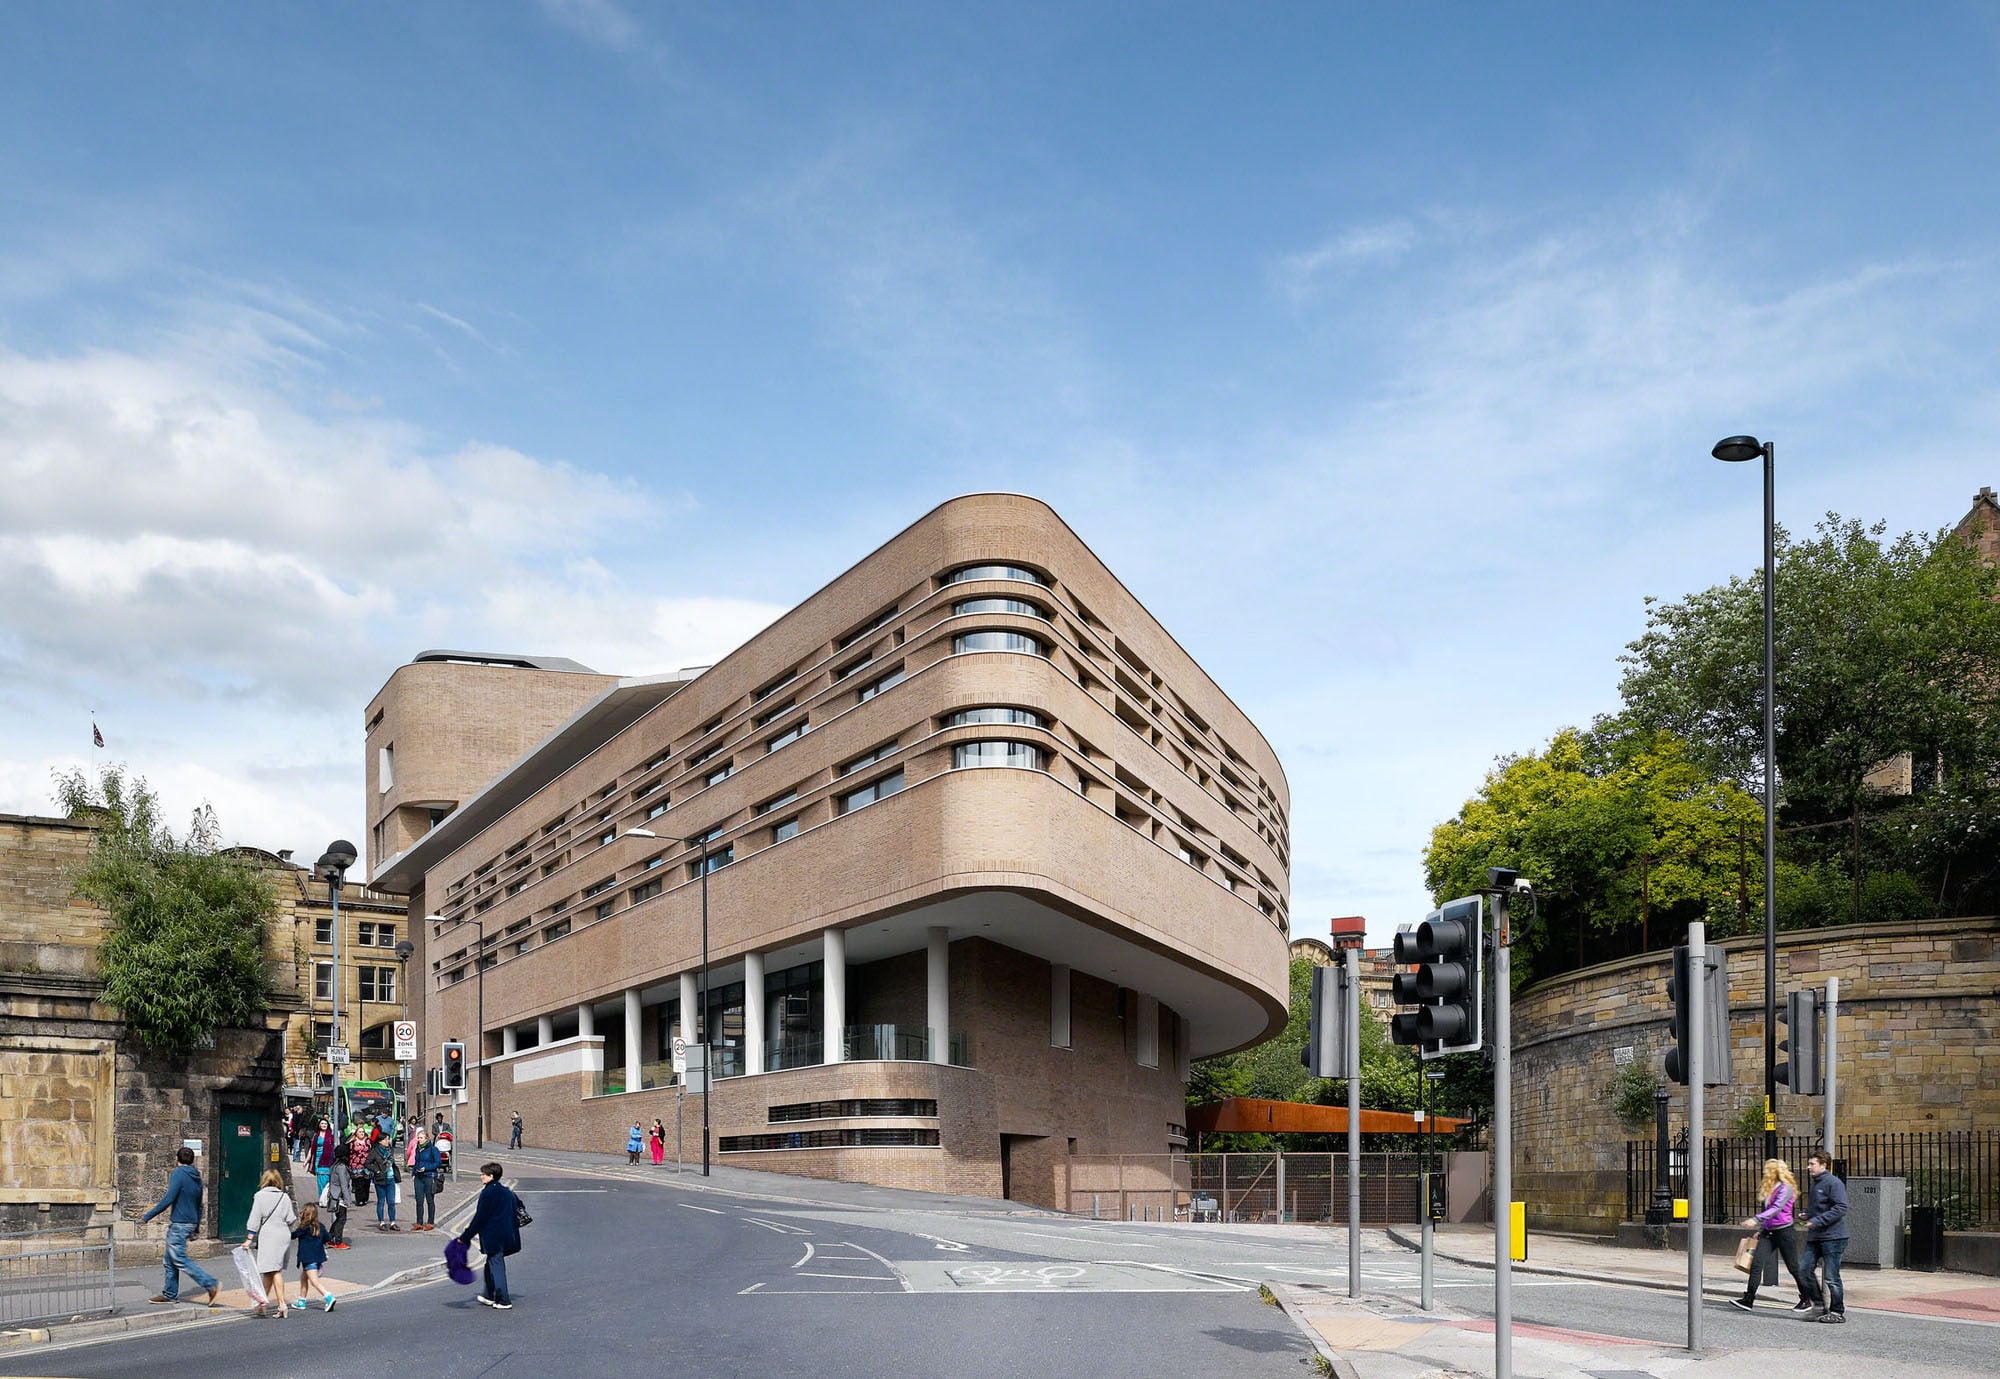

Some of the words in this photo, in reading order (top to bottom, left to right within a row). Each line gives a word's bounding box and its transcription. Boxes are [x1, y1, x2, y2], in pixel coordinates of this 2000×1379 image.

[398, 1028, 412, 1036] 20
[676, 1043, 685, 1051] 20
[332, 1055, 345, 1063] BANK
